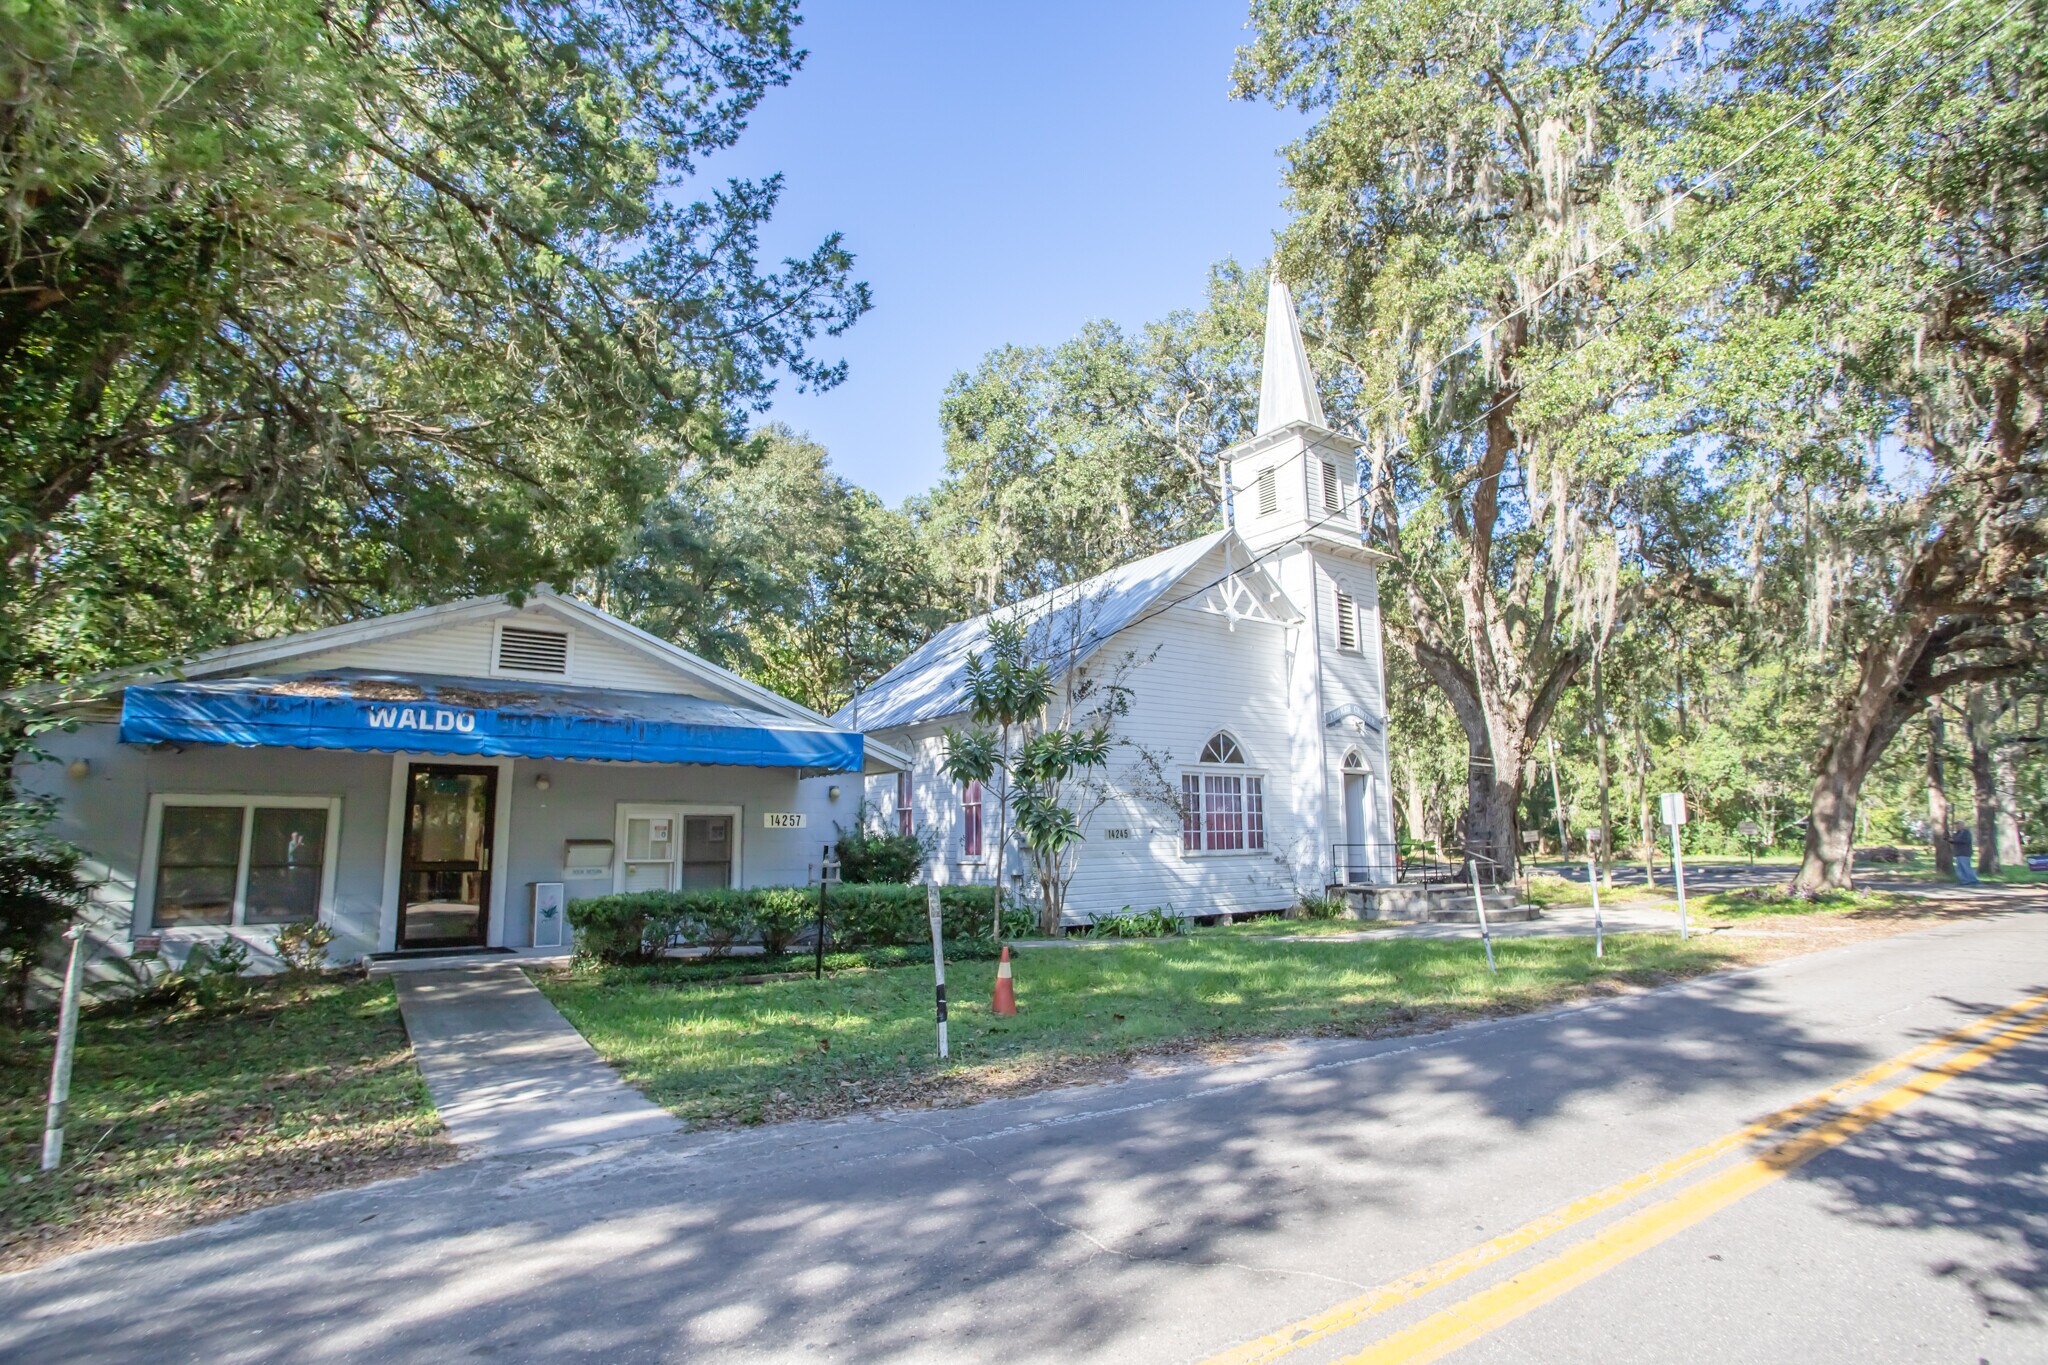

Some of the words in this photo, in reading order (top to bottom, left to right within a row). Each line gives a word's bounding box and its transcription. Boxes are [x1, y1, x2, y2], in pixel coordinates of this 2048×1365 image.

[369, 706, 475, 732] WALDO
[770, 814, 801, 827] 14257
[1108, 829, 1129, 839] 14245
